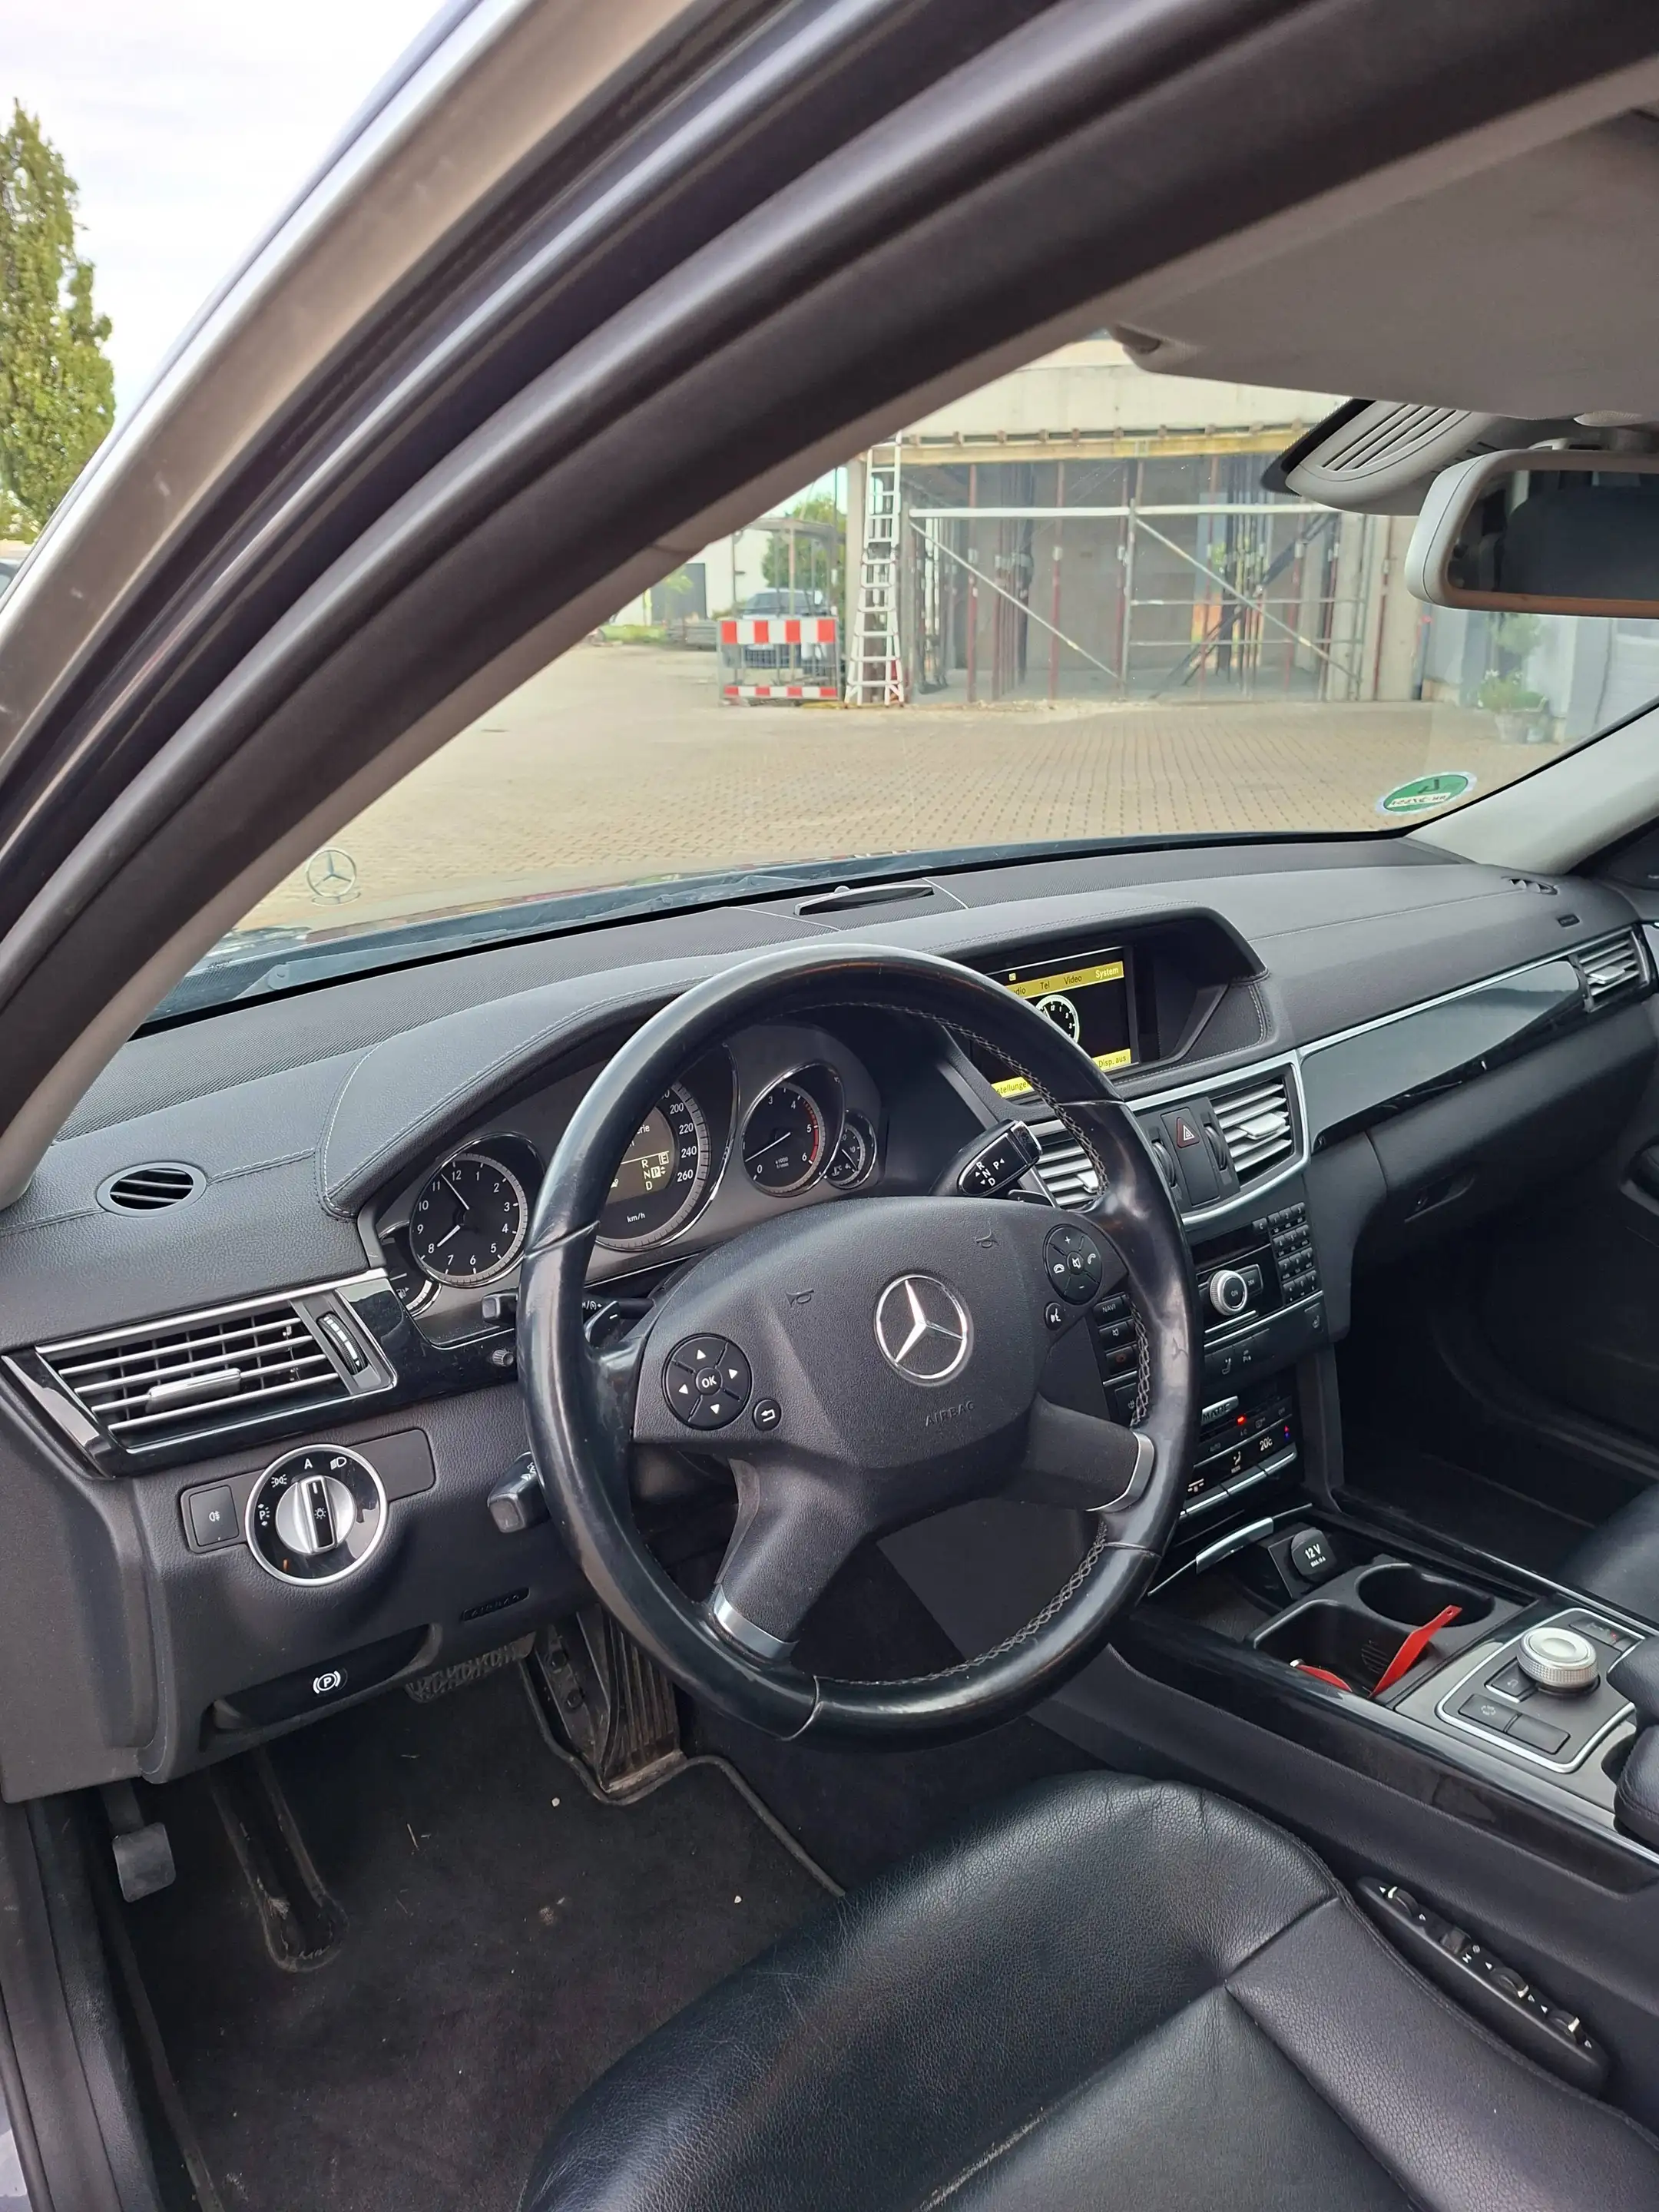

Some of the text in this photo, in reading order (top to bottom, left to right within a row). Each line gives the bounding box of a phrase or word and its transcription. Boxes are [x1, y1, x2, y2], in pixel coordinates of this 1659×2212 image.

[1040, 982, 1050, 990] Tel
[1063, 975, 1082, 985] Video
[1095, 967, 1119, 979] System
[1098, 1055, 1127, 1068] Disp. aus
[996, 1081, 1028, 1094] stellunge
[670, 1102, 684, 1114] 200
[790, 1101, 796, 1109] 4
[679, 1122, 694, 1135] 220
[806, 1124, 812, 1133] 5
[680, 1145, 697, 1158] 240
[802, 1153, 807, 1161] 6
[641, 1159, 649, 1169] R
[757, 1165, 763, 1174] 0
[975, 1161, 985, 1171] R
[992, 1161, 1000, 1171] P
[452, 1170, 462, 1181] 12
[476, 1171, 480, 1181] 1
[644, 1170, 651, 1180] N
[677, 1169, 694, 1183] 260
[982, 1169, 991, 1179] N
[432, 1180, 440, 1192] 11
[493, 1182, 499, 1193] 2
[645, 1181, 653, 1191] D
[988, 1177, 996, 1187] D
[419, 1200, 429, 1211] 10
[504, 1201, 510, 1212] 3
[626, 1212, 646, 1223] km/h
[417, 1224, 424, 1234] 9
[502, 1223, 508, 1233] 4
[428, 1243, 435, 1253] 8
[490, 1242, 497, 1253] 5
[447, 1254, 454, 1265] 7
[469, 1254, 476, 1265] 6
[1102, 1303, 1117, 1313] NAVI
[701, 1375, 717, 1388] OK
[926, 1400, 975, 1426] AIRBAG
[304, 1459, 313, 1469] A
